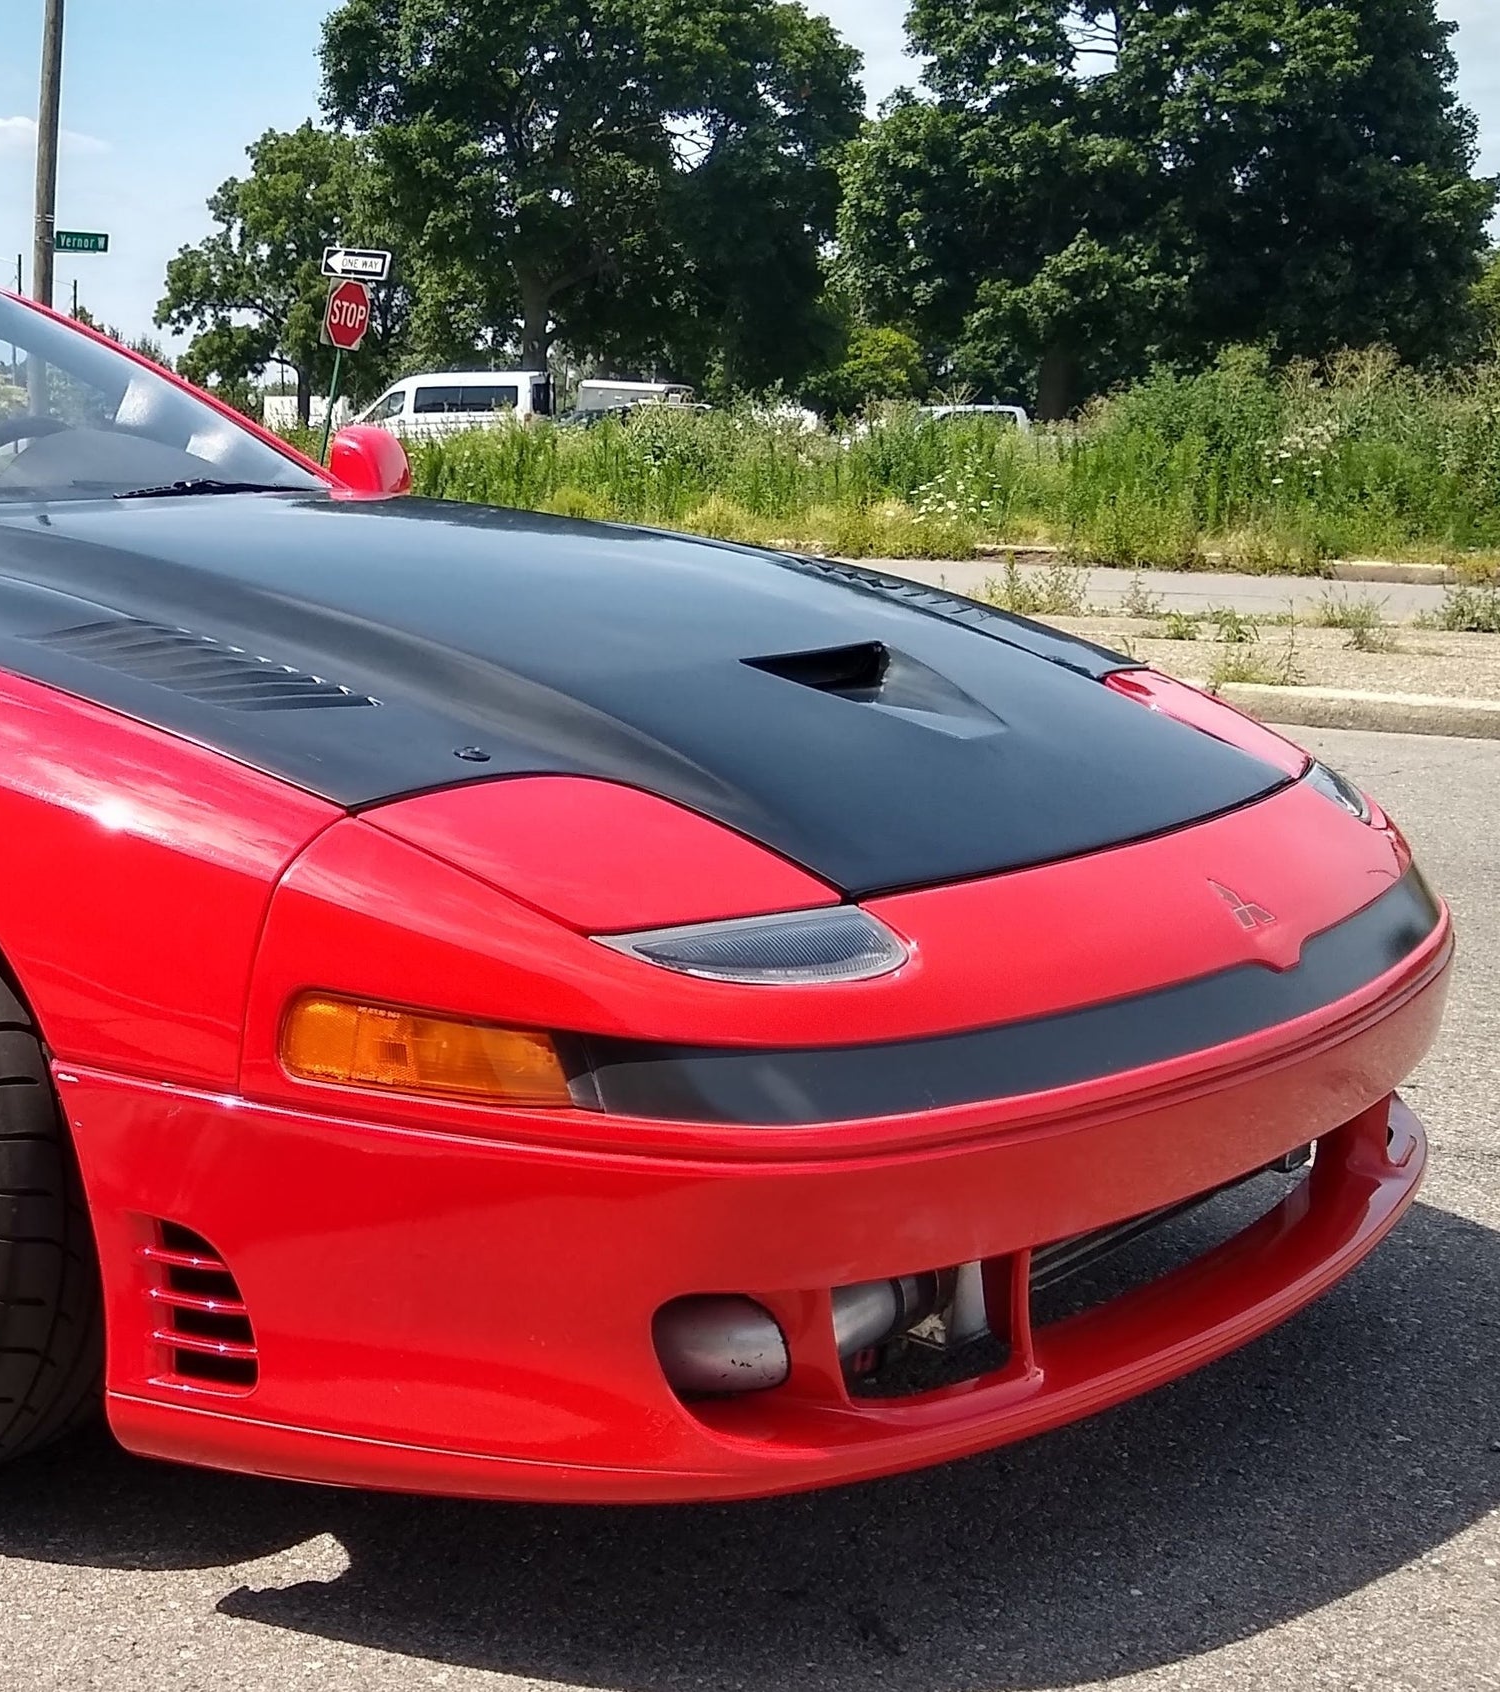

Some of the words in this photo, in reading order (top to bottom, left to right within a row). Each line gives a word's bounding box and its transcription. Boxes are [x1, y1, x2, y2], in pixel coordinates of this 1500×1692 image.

[60, 234, 95, 249] Vernor
[97, 236, 106, 249] W
[341, 257, 358, 269] ONE
[361, 259, 379, 271] WAY
[330, 299, 367, 329] STOP
